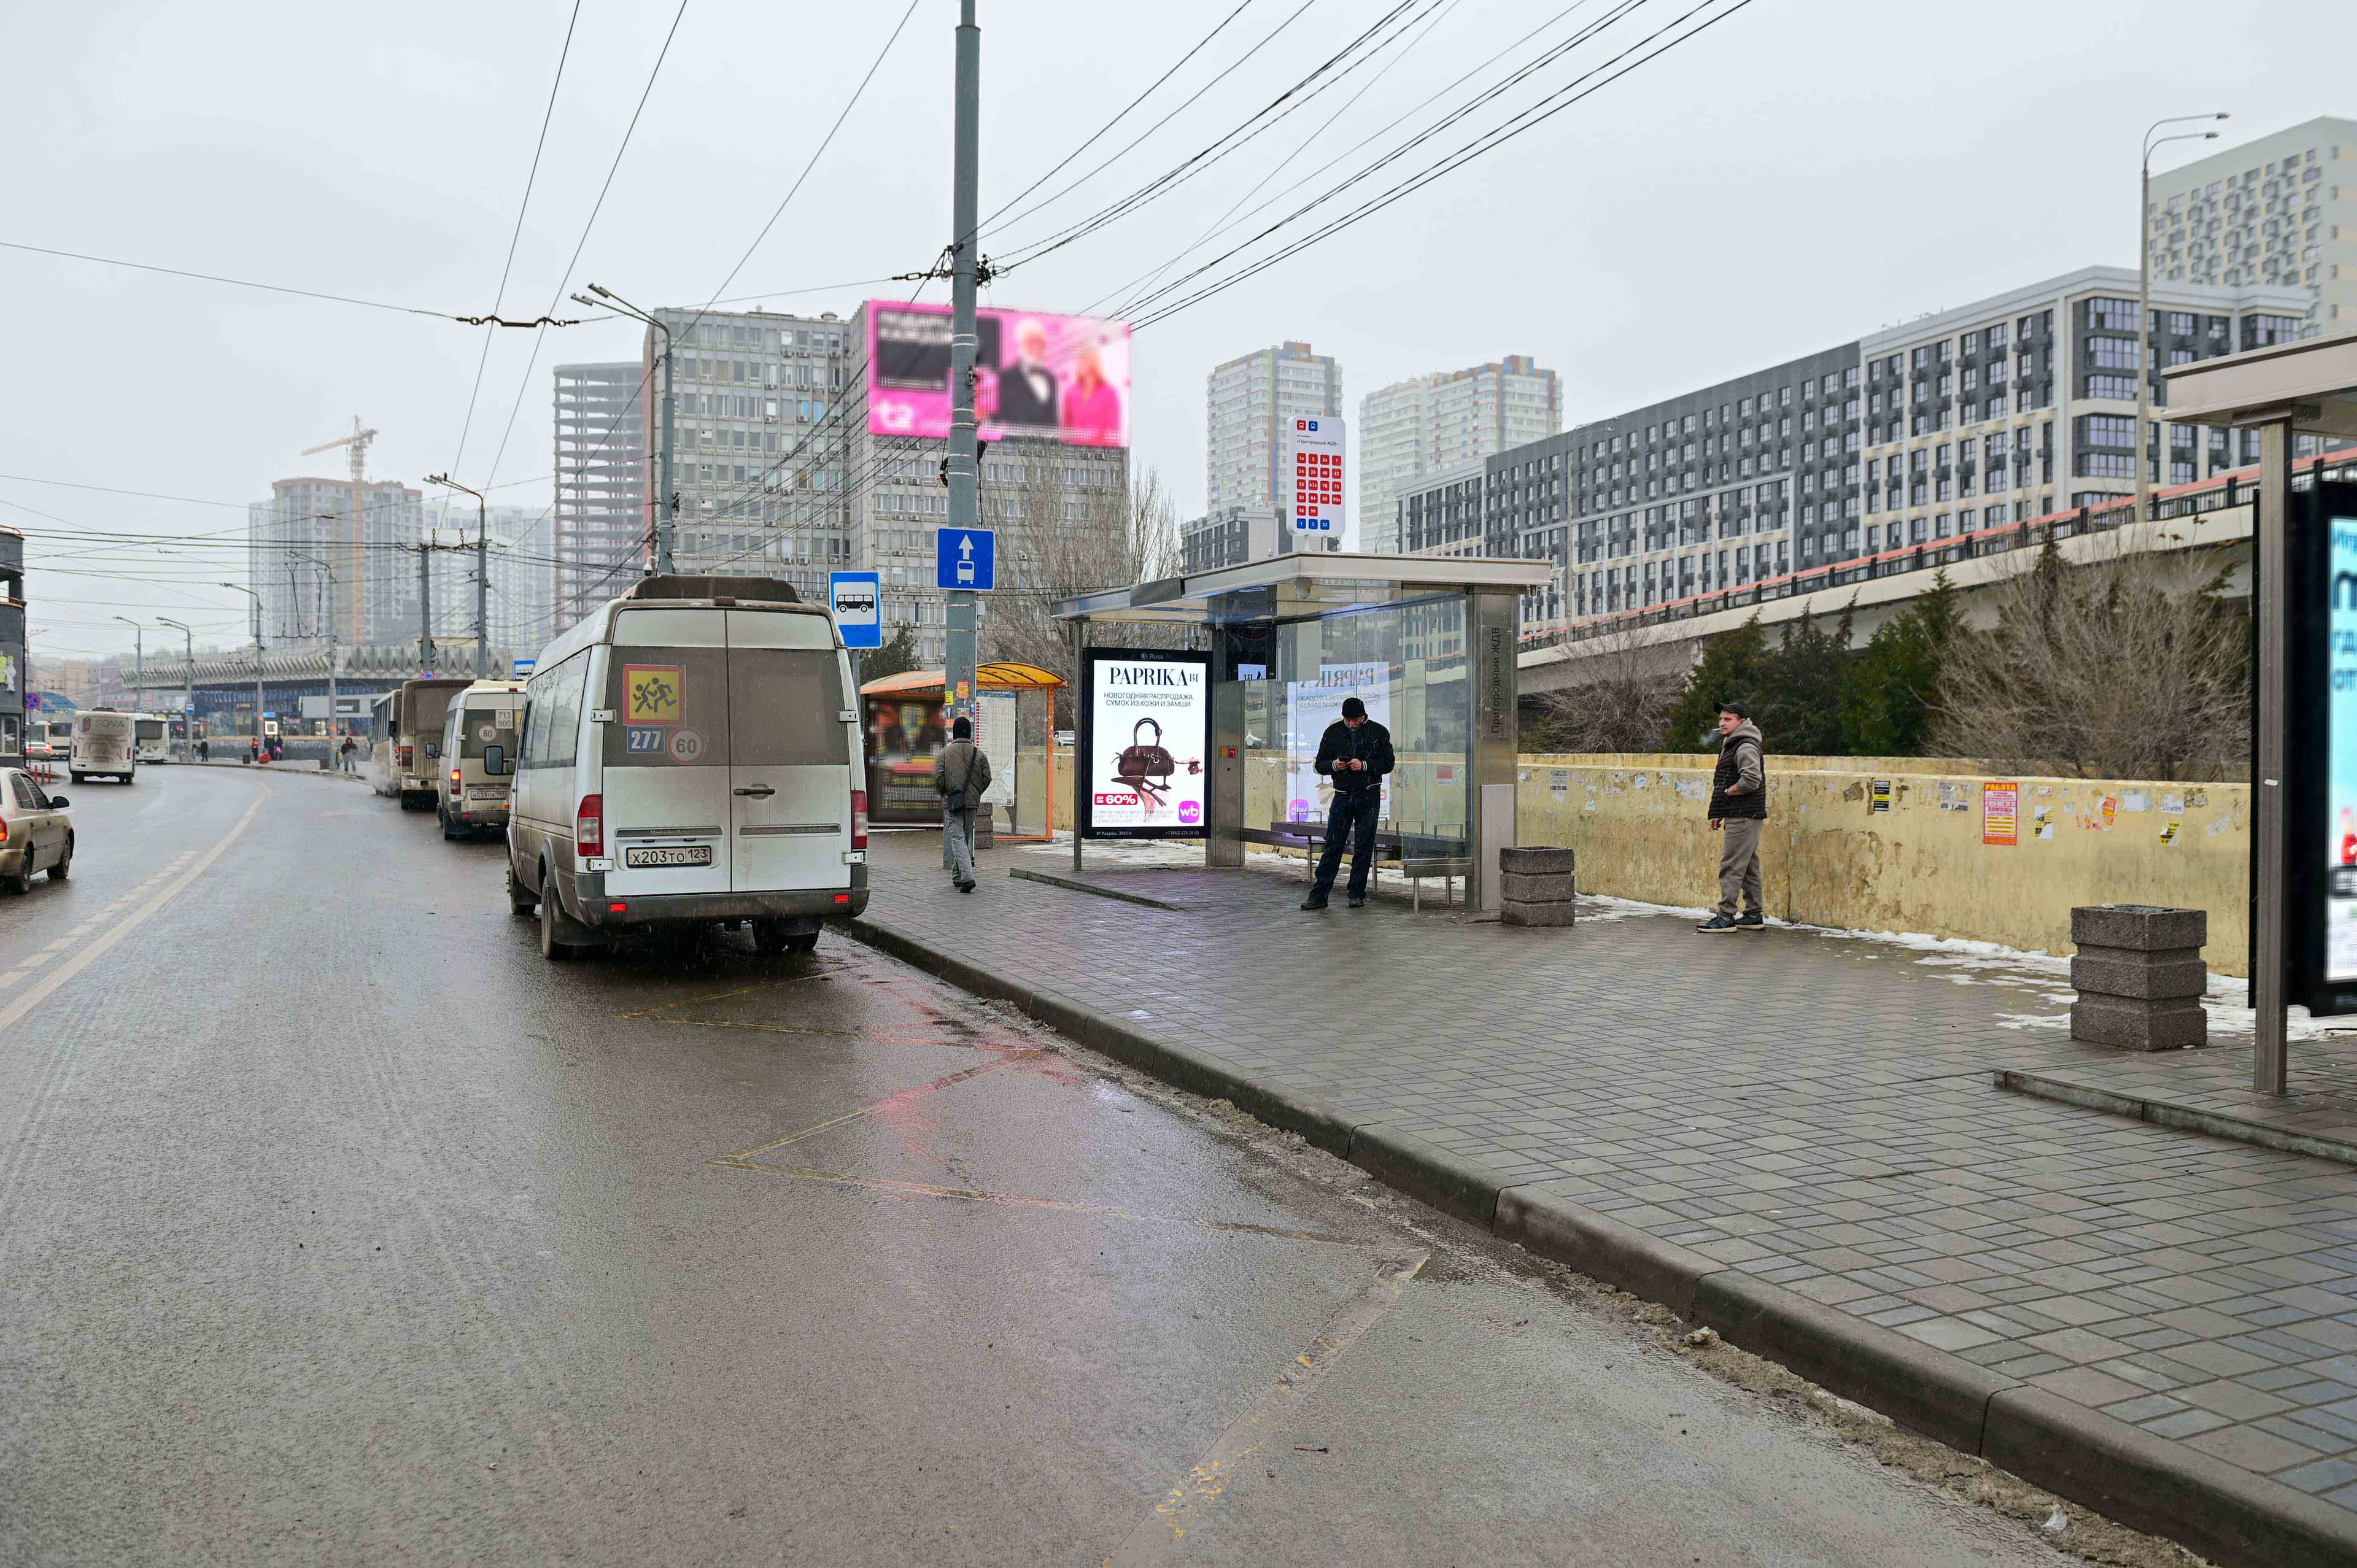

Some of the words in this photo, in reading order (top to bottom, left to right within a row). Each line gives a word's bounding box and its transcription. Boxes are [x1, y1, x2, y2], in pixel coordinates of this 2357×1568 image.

[1492, 627, 1501, 654] ЖДВ
[1109, 667, 1188, 686] PAPRIKA
[1491, 657, 1501, 733] Пригородный
[95, 719, 125, 728] SOVA
[482, 729, 492, 738] 60
[631, 730, 662, 749] 277
[676, 738, 697, 754] 60
[1180, 805, 1199, 817] wb
[687, 849, 706, 859] 123
